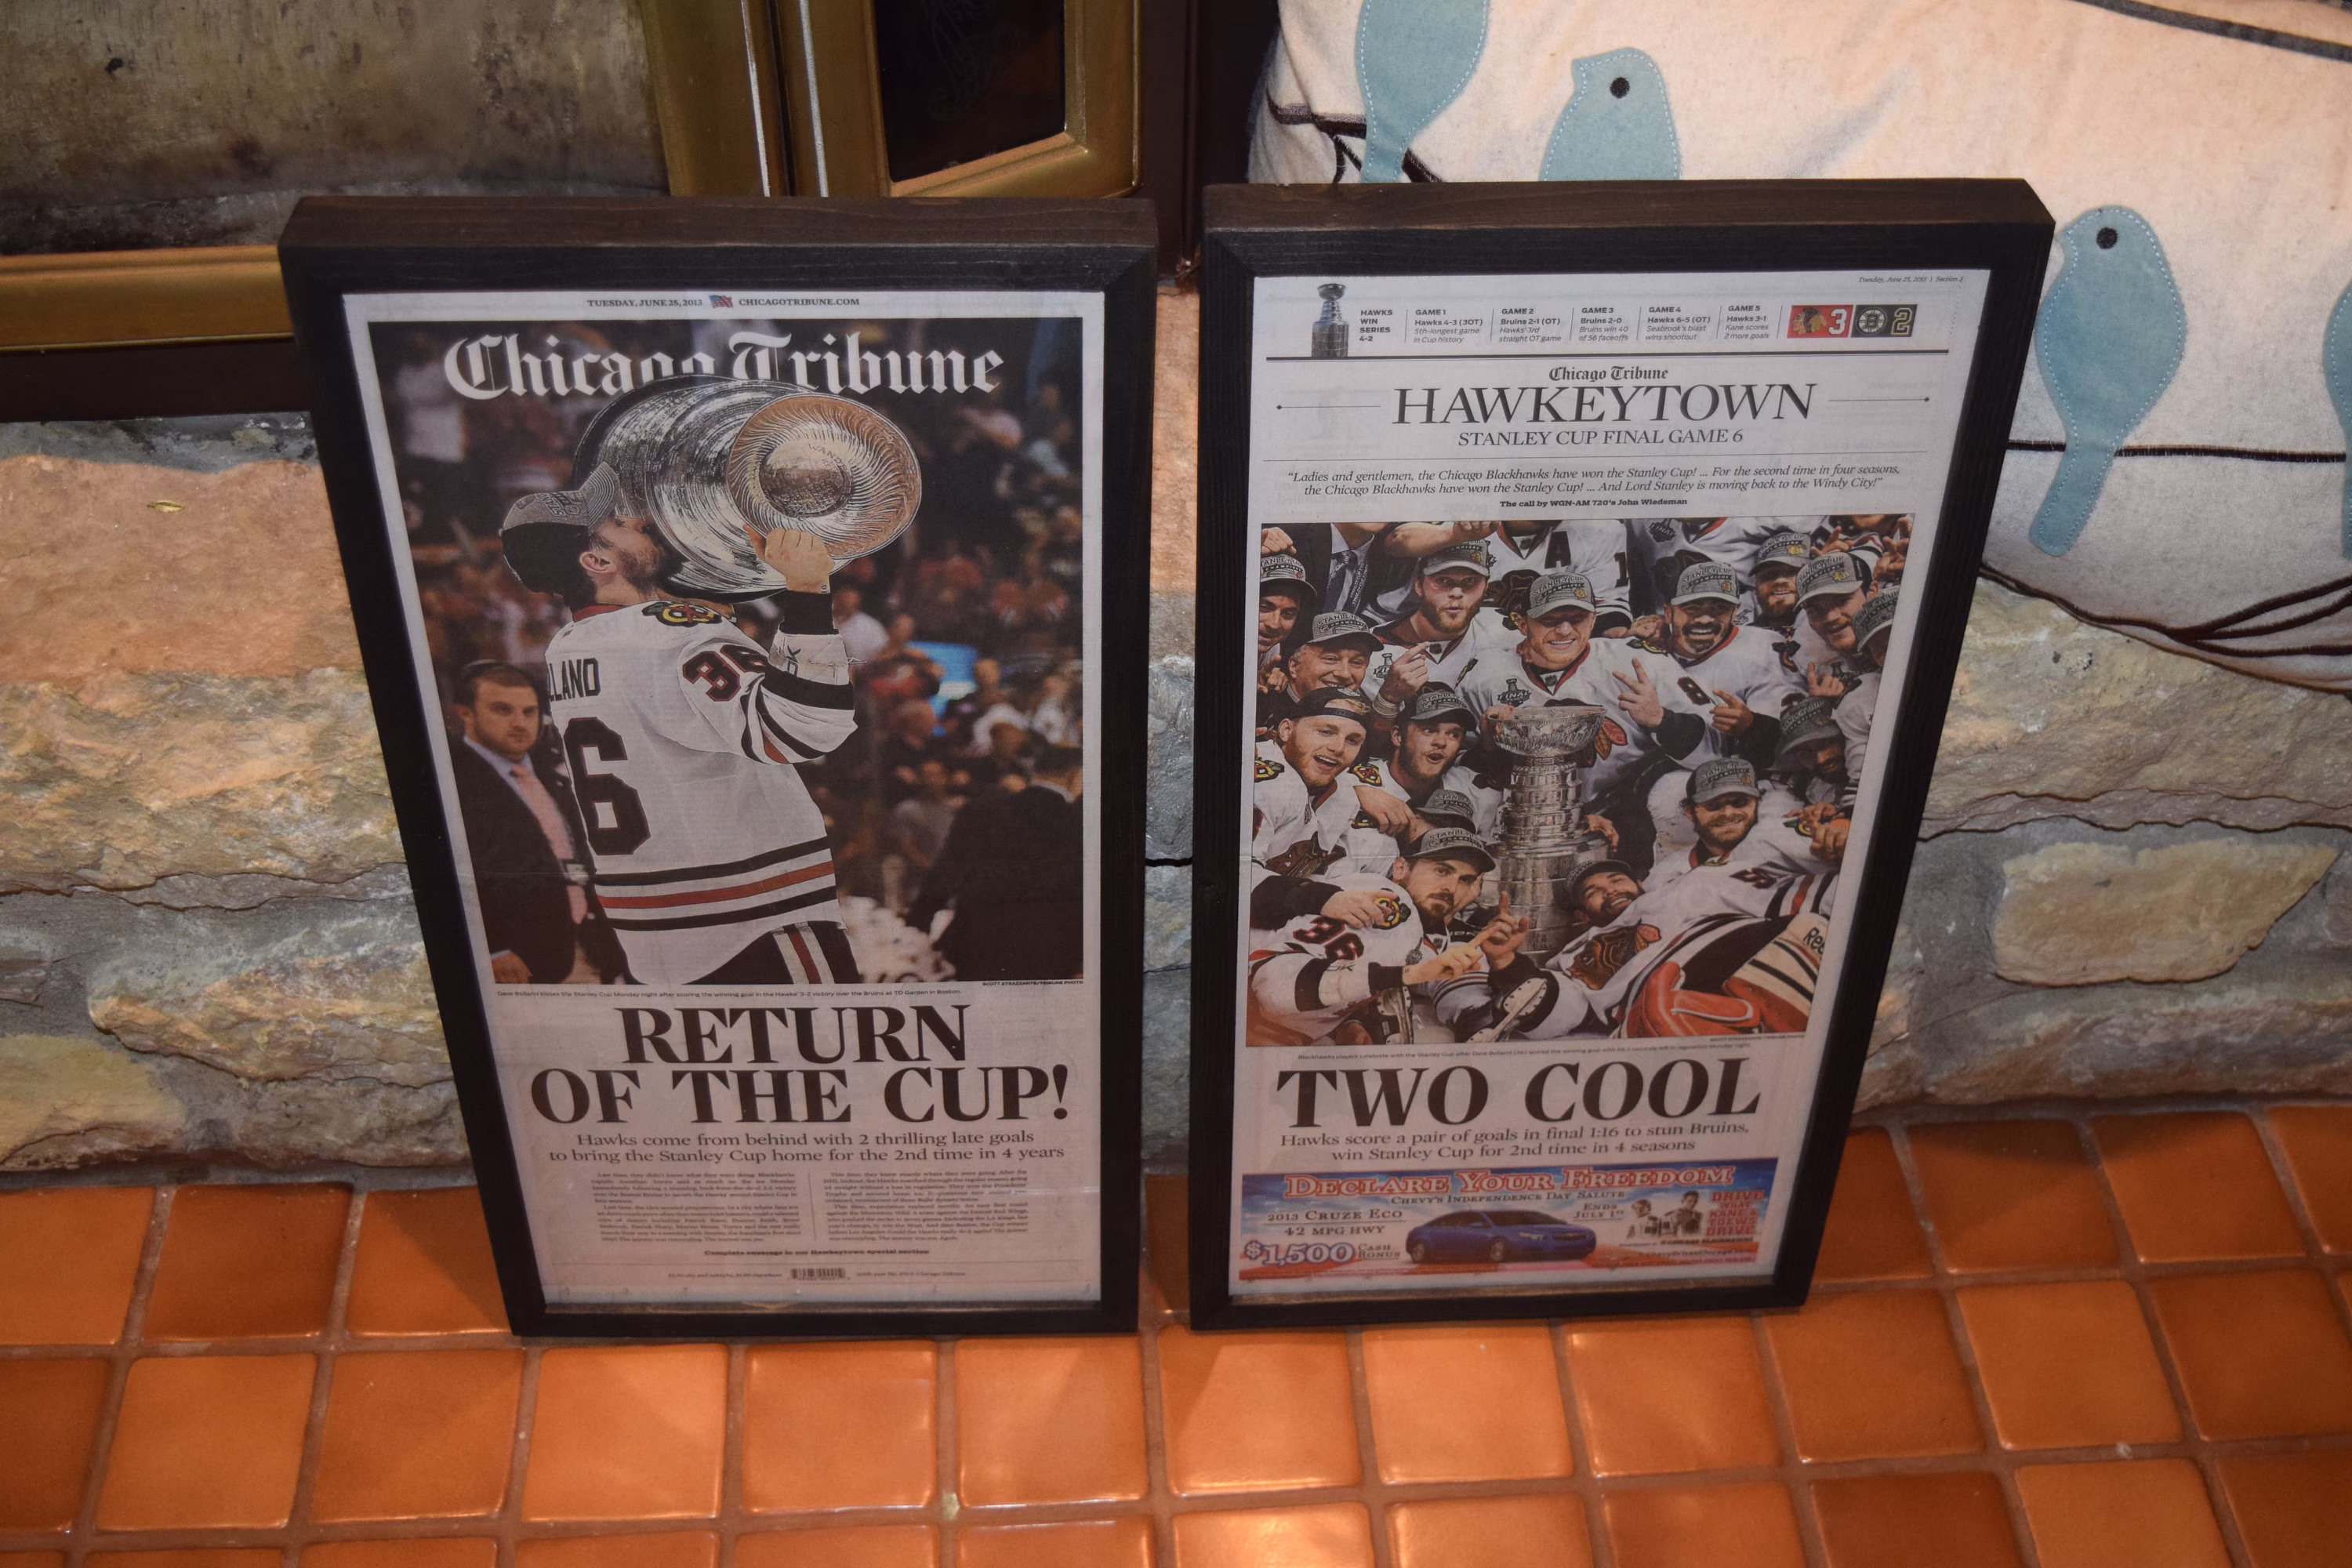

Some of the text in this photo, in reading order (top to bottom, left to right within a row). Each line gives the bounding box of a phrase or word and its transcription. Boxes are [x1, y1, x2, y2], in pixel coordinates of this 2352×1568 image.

[1828, 308, 1847, 335] 3
[1891, 307, 1912, 336] 2
[731, 331, 1006, 394] Tribune
[1548, 365, 1668, 383] Chicago Tribune
[1392, 383, 1819, 424] HAWKEYTOWN
[1458, 429, 1743, 446] STANLEY CUP FINAL GAME 6
[1331, 470, 1353, 481] and
[1417, 470, 1436, 480] the
[1437, 469, 1483, 482] Chicago
[1486, 468, 1550, 479] Blackhawks
[1552, 468, 1578, 478] have
[1606, 467, 1624, 477] the
[1626, 466, 1668, 480] Stanley
[1669, 466, 1697, 480] Cup!
[1712, 466, 1730, 477] For
[1733, 466, 1751, 476] the
[1753, 465, 1791, 476] second
[1792, 465, 1817, 475] time
[1819, 465, 1830, 475] in
[1833, 464, 1856, 475] four
[1303, 485, 1323, 495] the
[1323, 484, 1370, 497] Chicago
[1372, 483, 1436, 494] Blackhawks
[1439, 483, 1467, 493] have
[1493, 482, 1511, 493] the
[1512, 482, 1554, 495] Stanley
[1555, 481, 1584, 495] Cup!
[1599, 481, 1622, 492] And
[1624, 481, 1652, 492] Lord
[1653, 480, 1693, 493] Stanley
[1697, 480, 1706, 490] is
[1708, 480, 1750, 492] moving
[1750, 479, 1776, 490] back
[1778, 479, 1790, 489] to
[1791, 479, 1809, 489] the
[1812, 478, 1848, 492] Windy
[1536, 500, 1548, 509] by
[1544, 530, 1572, 570] A
[614, 1005, 972, 1063] RETURN
[531, 1065, 1069, 1124] OF THE CUP!
[1276, 1058, 1763, 1128] TWO COOL
[577, 1131, 1033, 1148] Hawks come from behind with 2 thrilling late goals
[1281, 1133, 1340, 1145] Hawks
[1345, 1134, 1391, 1144] score
[1396, 1134, 1406, 1143] a
[1412, 1130, 1446, 1145] pair
[1451, 1129, 1471, 1142] of
[1474, 1128, 1518, 1144] goals
[1524, 1127, 1540, 1140] in
[1546, 1127, 1584, 1139] final
[1589, 1126, 1619, 1138] 1:16
[1624, 1125, 1642, 1137] to
[1646, 1124, 1683, 1137] stun
[549, 1146, 1064, 1167] to bring the Stanley Cup home for the 2nd time in 4 years
[1330, 1142, 1695, 1163] win Stanley Cup for 2nd time in 4 seasons
[1283, 1166, 1736, 1198] DECLARE YOUR FREEDOM
[1305, 1210, 1363, 1221] CRUZE
[1369, 1208, 1403, 1218] ECO
[1245, 1240, 1356, 1267] $1,500
